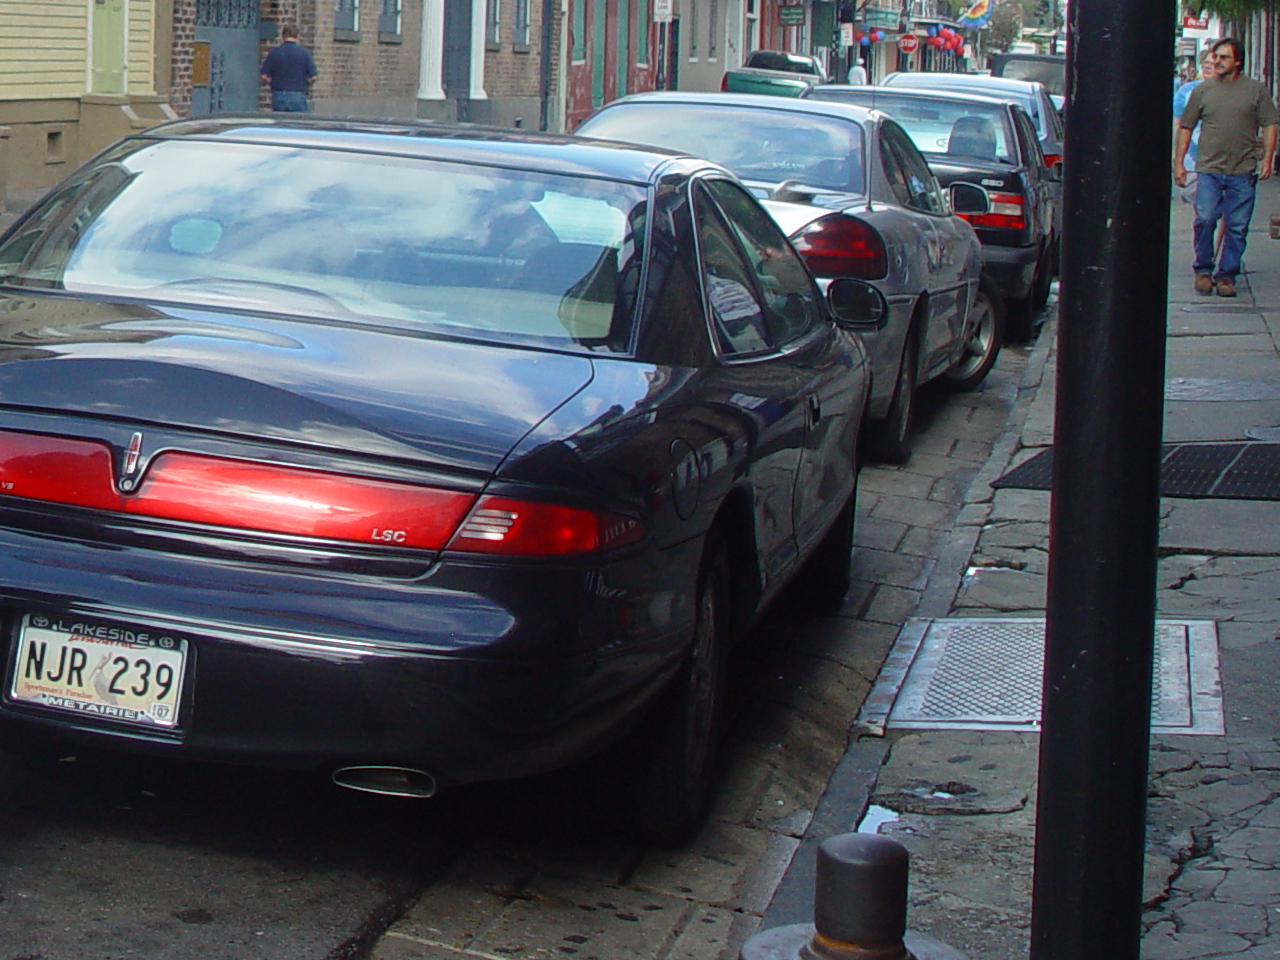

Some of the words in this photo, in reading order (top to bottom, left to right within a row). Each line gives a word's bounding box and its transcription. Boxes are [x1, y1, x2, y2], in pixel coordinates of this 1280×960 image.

[900, 39, 917, 47] STOP
[371, 528, 407, 543] LSC
[25, 640, 88, 687] NJR
[108, 656, 174, 701] 239
[48, 696, 139, 719] METAIRIE
[157, 707, 170, 718] 07
